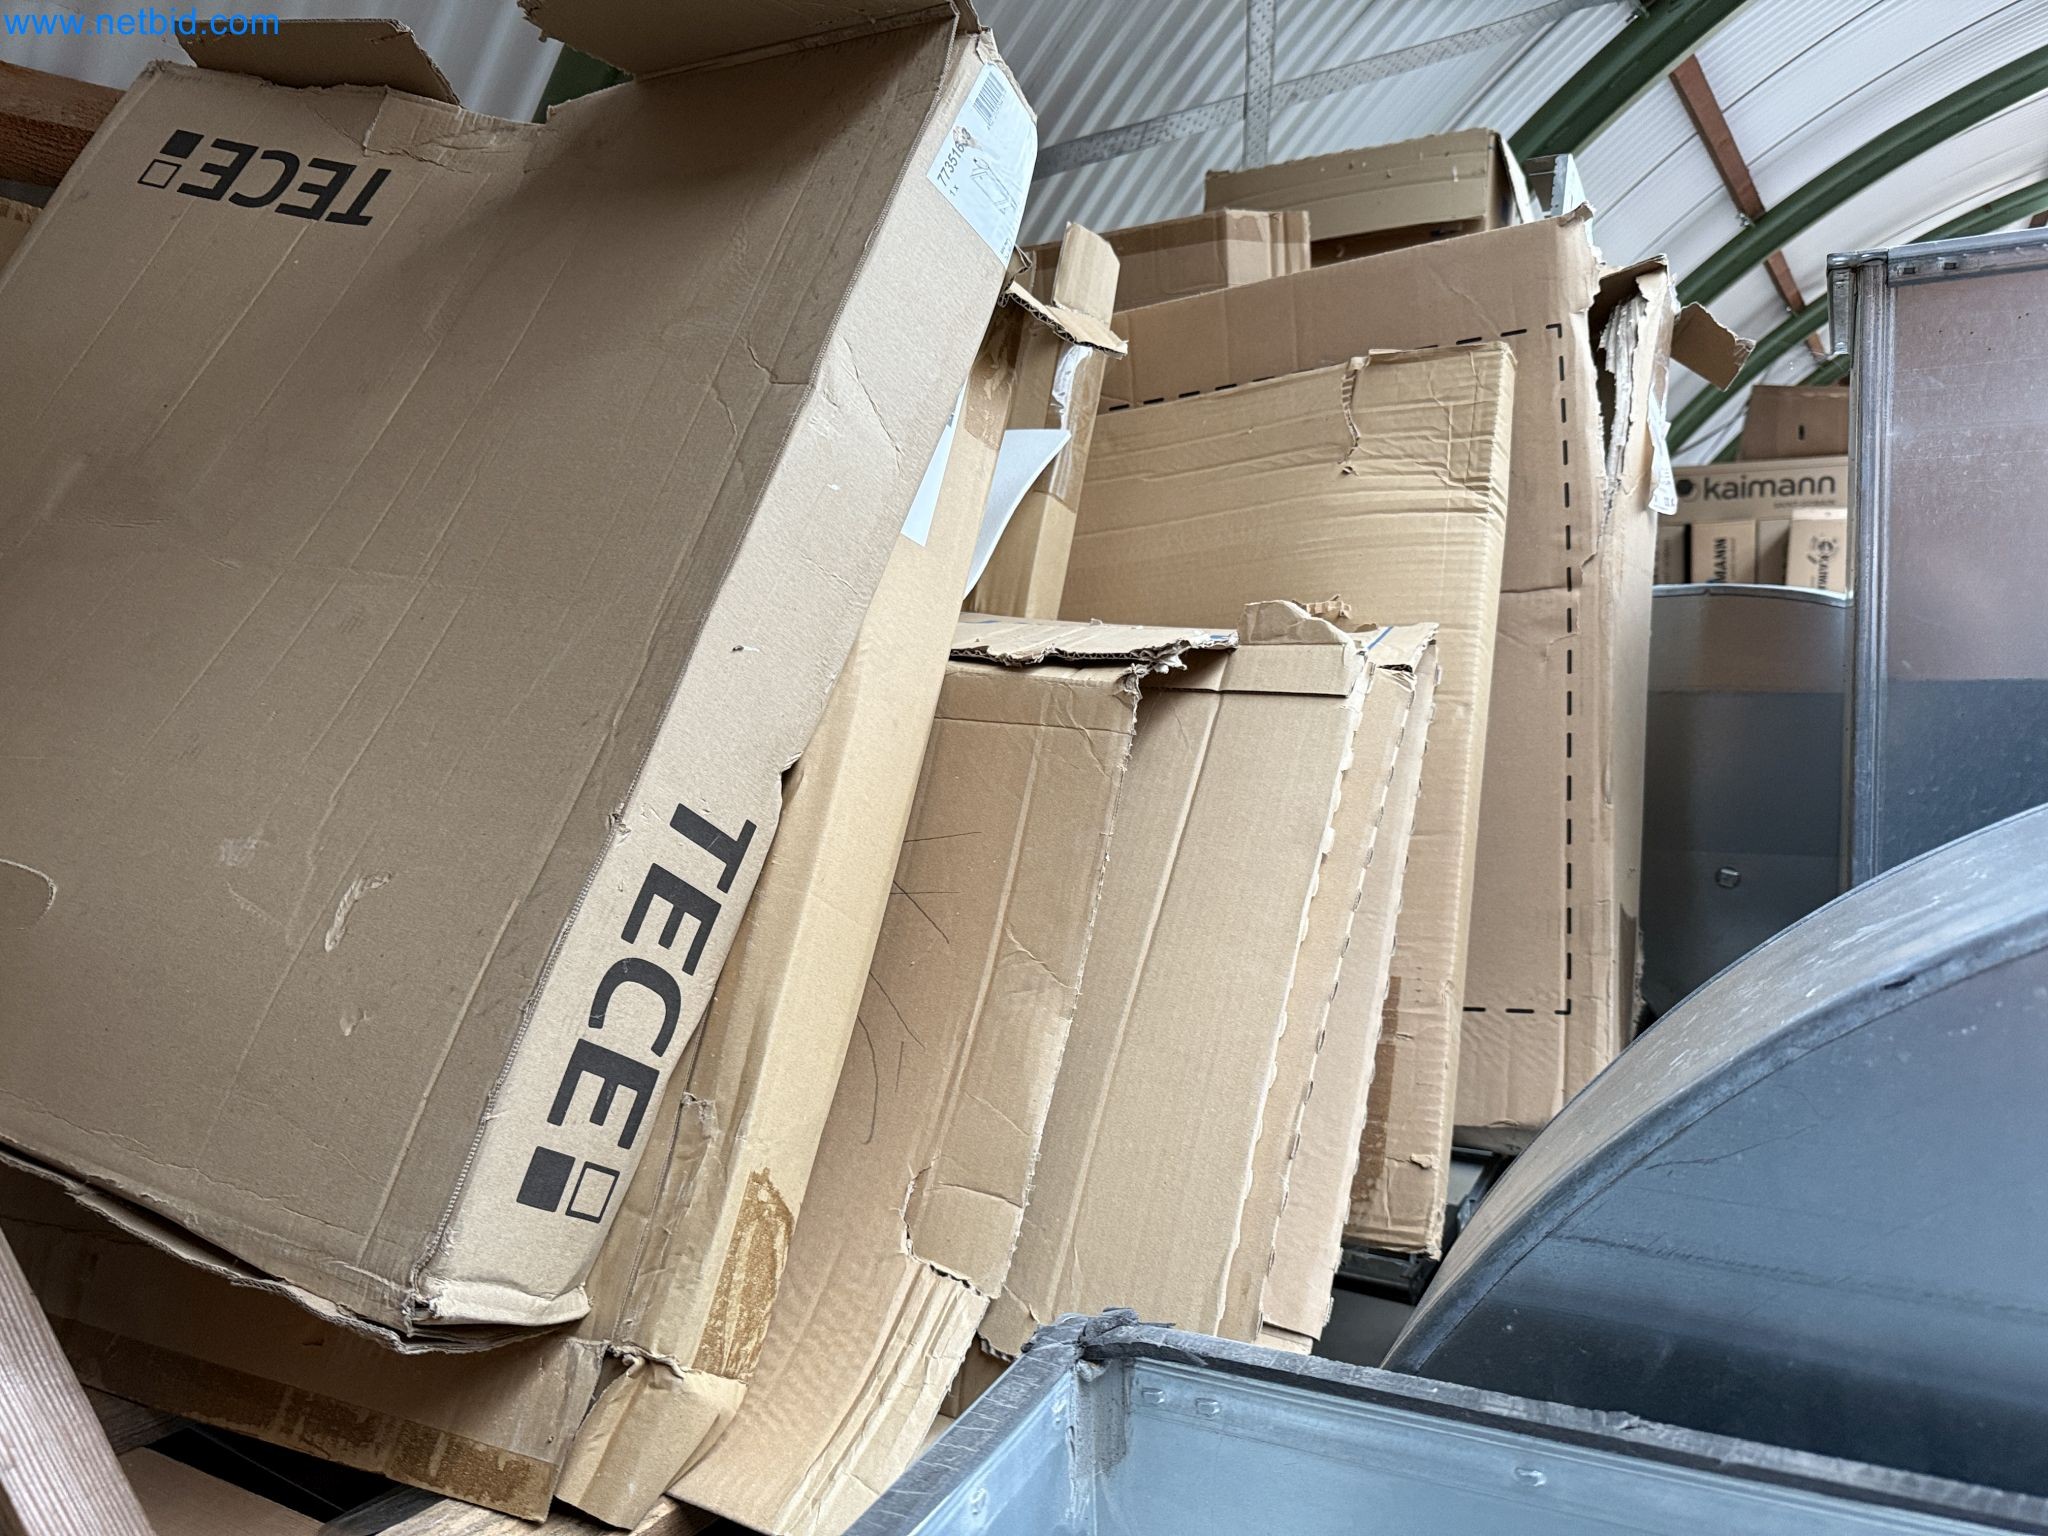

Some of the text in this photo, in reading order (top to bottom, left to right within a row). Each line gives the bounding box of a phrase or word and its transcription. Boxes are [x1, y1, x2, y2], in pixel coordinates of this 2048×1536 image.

[177, 139, 392, 226] TECE
[937, 127, 972, 187] 7735163
[1703, 475, 1836, 501] kaimann
[547, 803, 757, 1150] TECE
